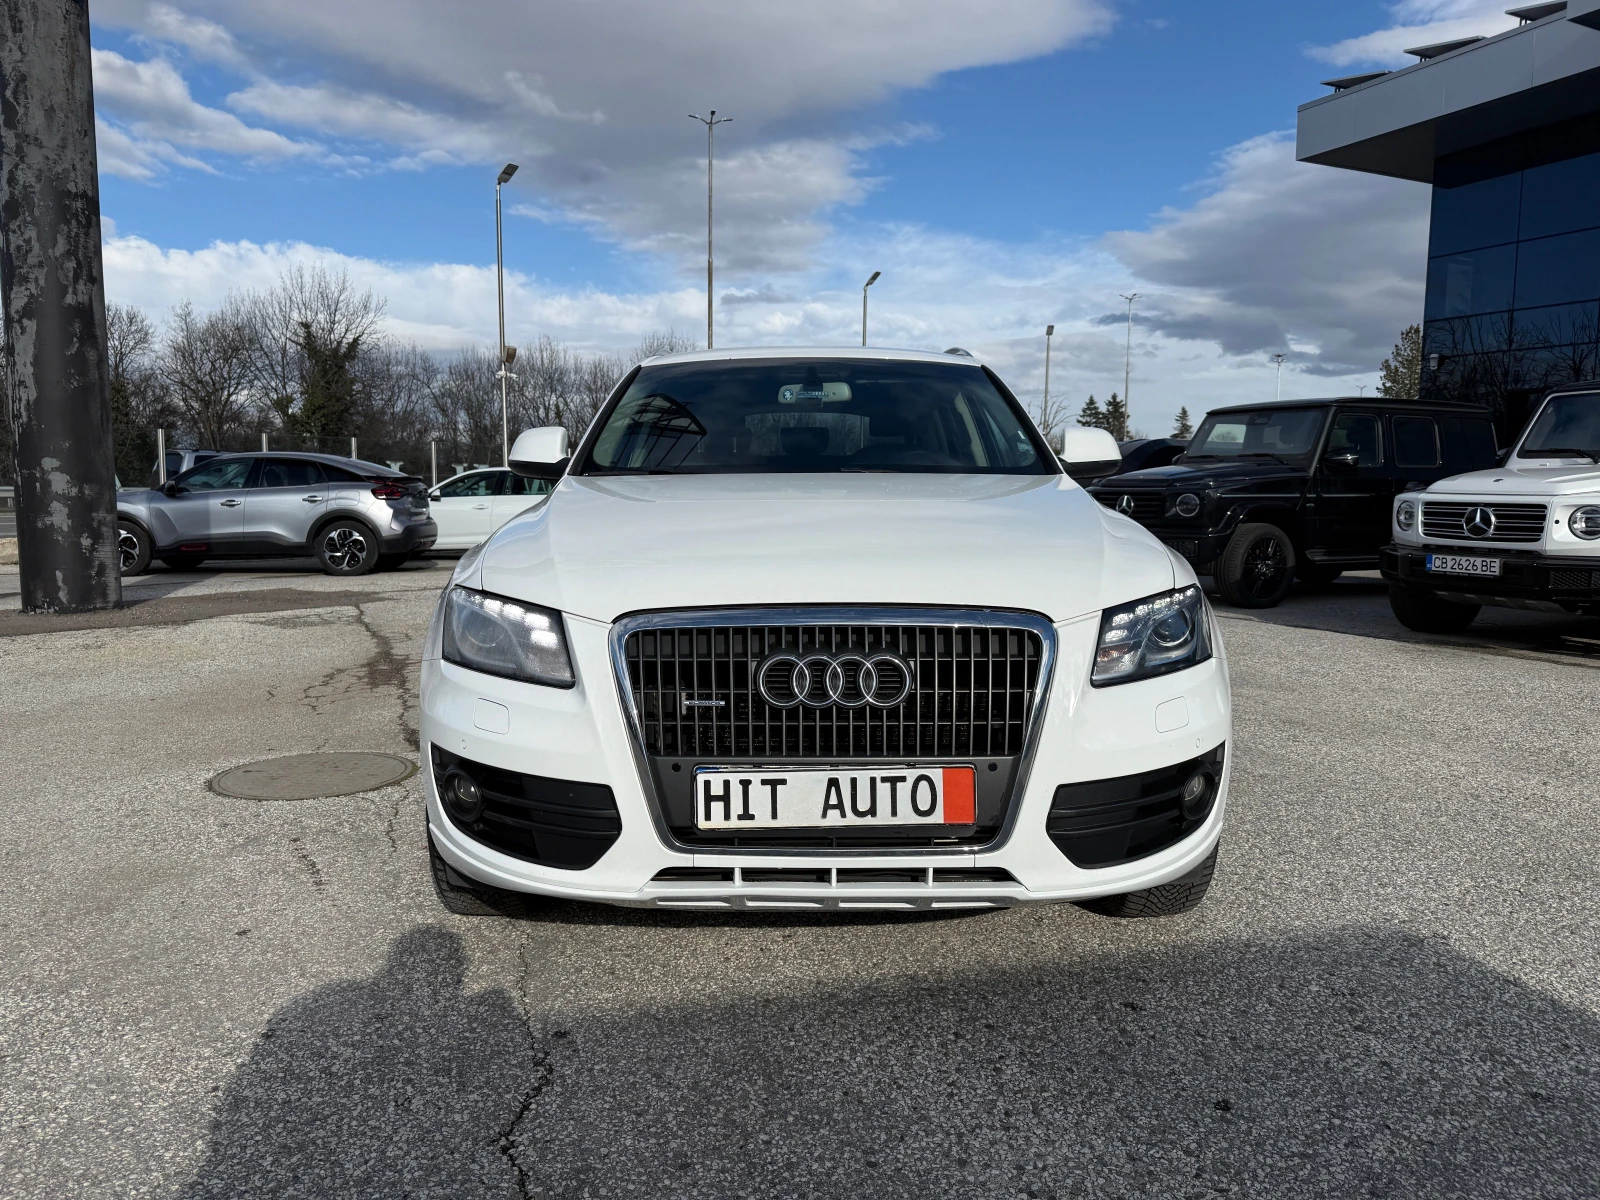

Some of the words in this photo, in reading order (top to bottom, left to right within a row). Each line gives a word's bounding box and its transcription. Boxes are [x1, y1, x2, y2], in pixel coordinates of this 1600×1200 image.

[1433, 557, 1448, 569] CB
[1450, 558, 1479, 571] 2626
[1481, 560, 1497, 573] BE
[703, 778, 788, 822] HIT
[821, 773, 938, 819] AUTO
